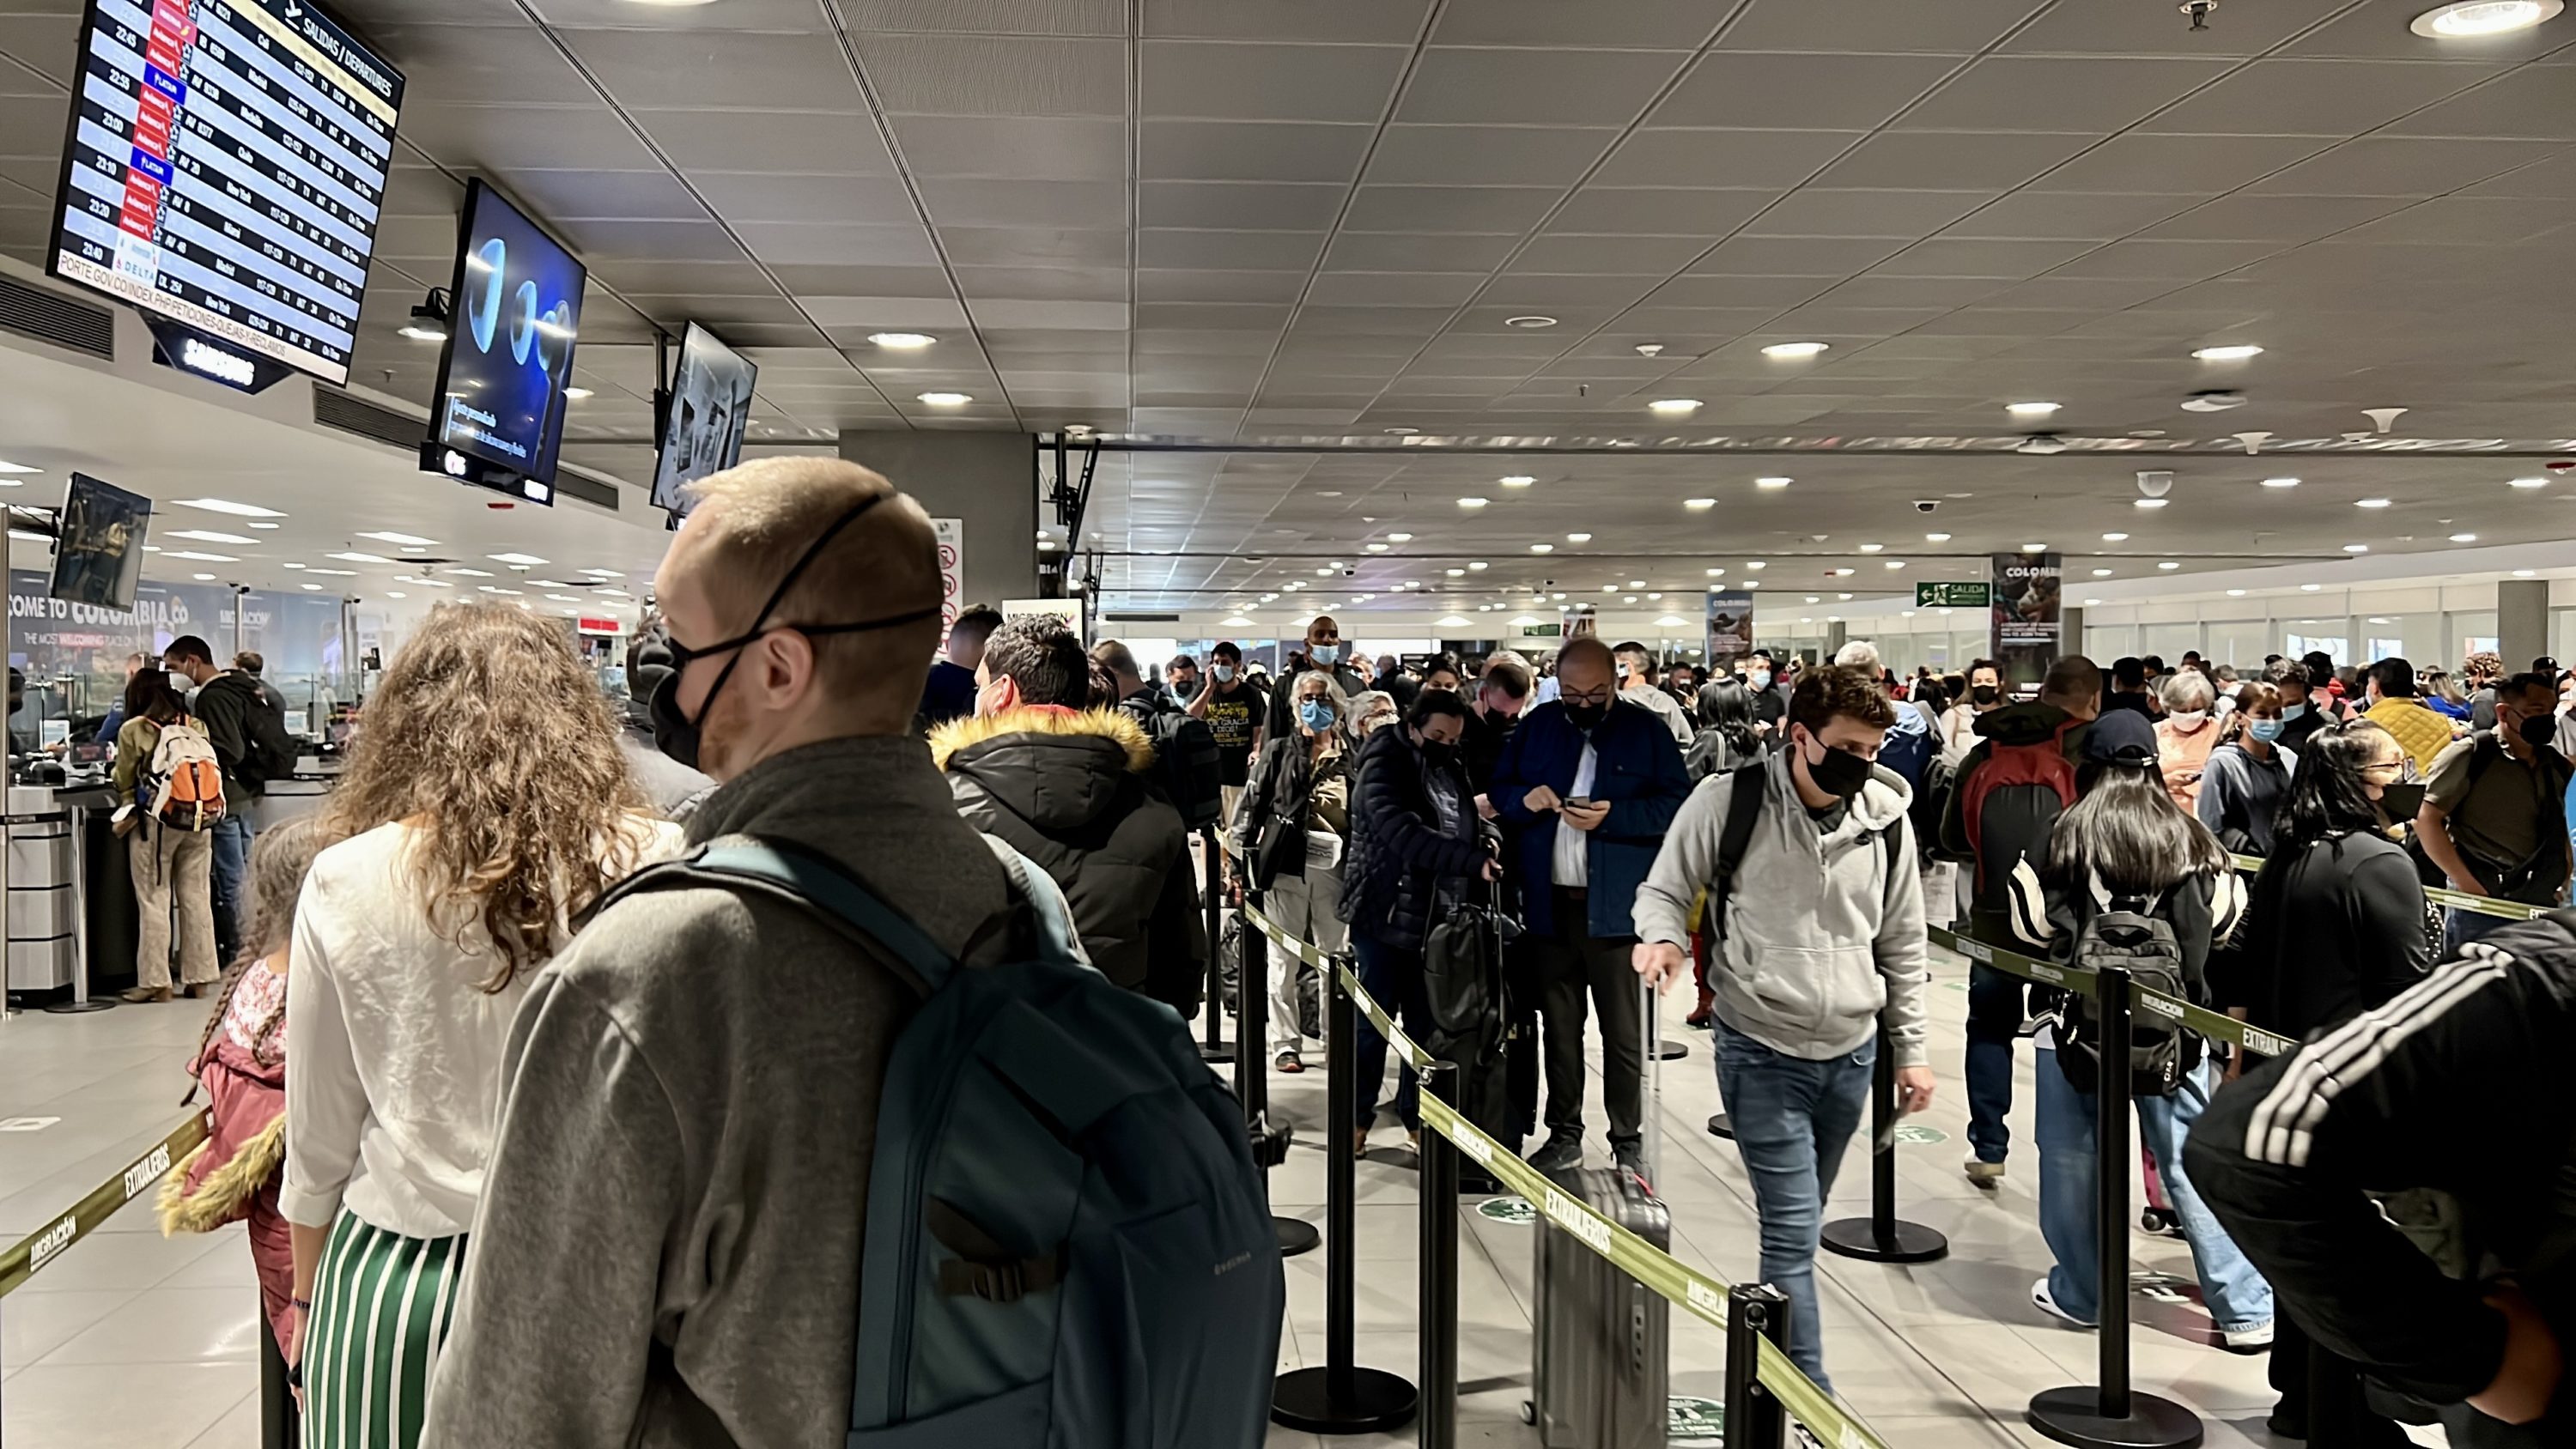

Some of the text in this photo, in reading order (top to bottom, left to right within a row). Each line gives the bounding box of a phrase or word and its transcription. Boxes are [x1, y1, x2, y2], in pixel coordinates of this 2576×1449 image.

[303, 17, 340, 57] SALIDAS
[344, 49, 392, 97] DEPARTURES
[125, 261, 153, 279] DELTA
[1951, 585, 1985, 594] SALIDA
[48, 597, 67, 619] TO
[24, 632, 37, 646] THE
[124, 1143, 170, 1200] EXTRANJEROS
[1546, 1186, 1612, 1255] EXTRANJEROS
[30, 1216, 76, 1264] MIGRACIÓN
